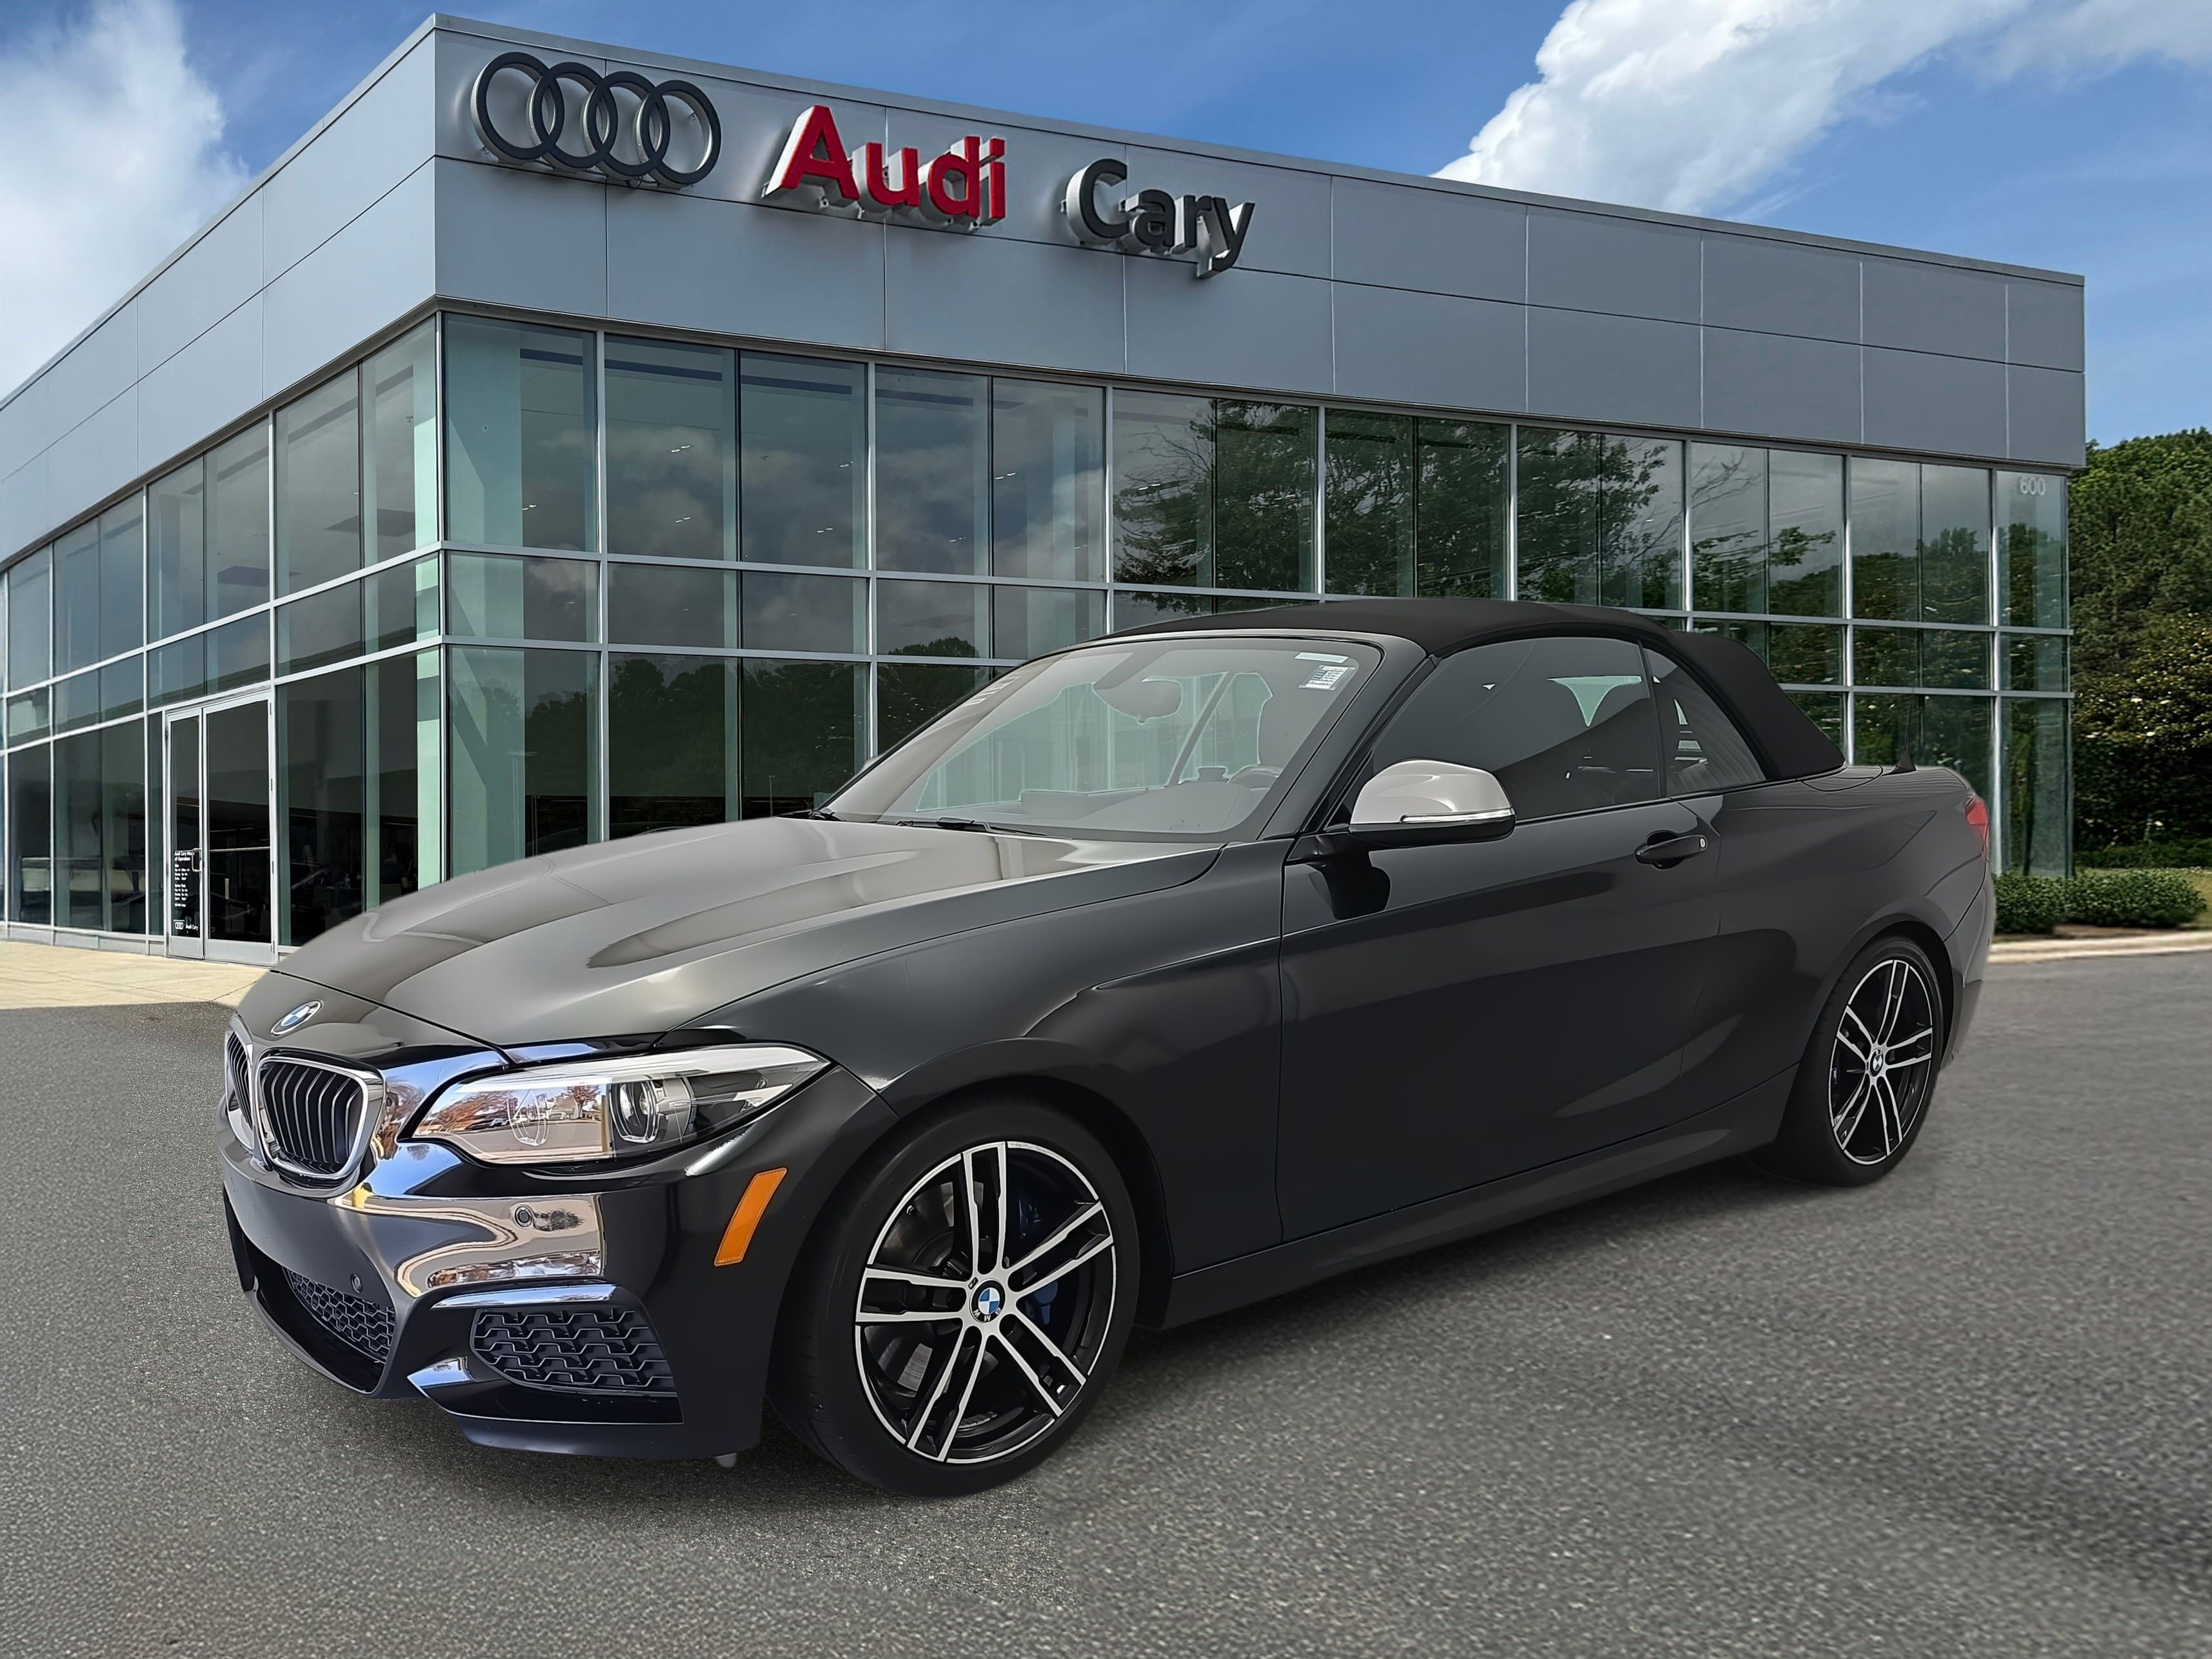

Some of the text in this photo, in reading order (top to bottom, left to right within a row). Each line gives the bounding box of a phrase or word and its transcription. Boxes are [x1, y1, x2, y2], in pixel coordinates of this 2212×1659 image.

[771, 104, 1255, 275] Audi Cary
[2020, 476, 2046, 496] 600
[973, 1307, 1002, 1322] BMW
